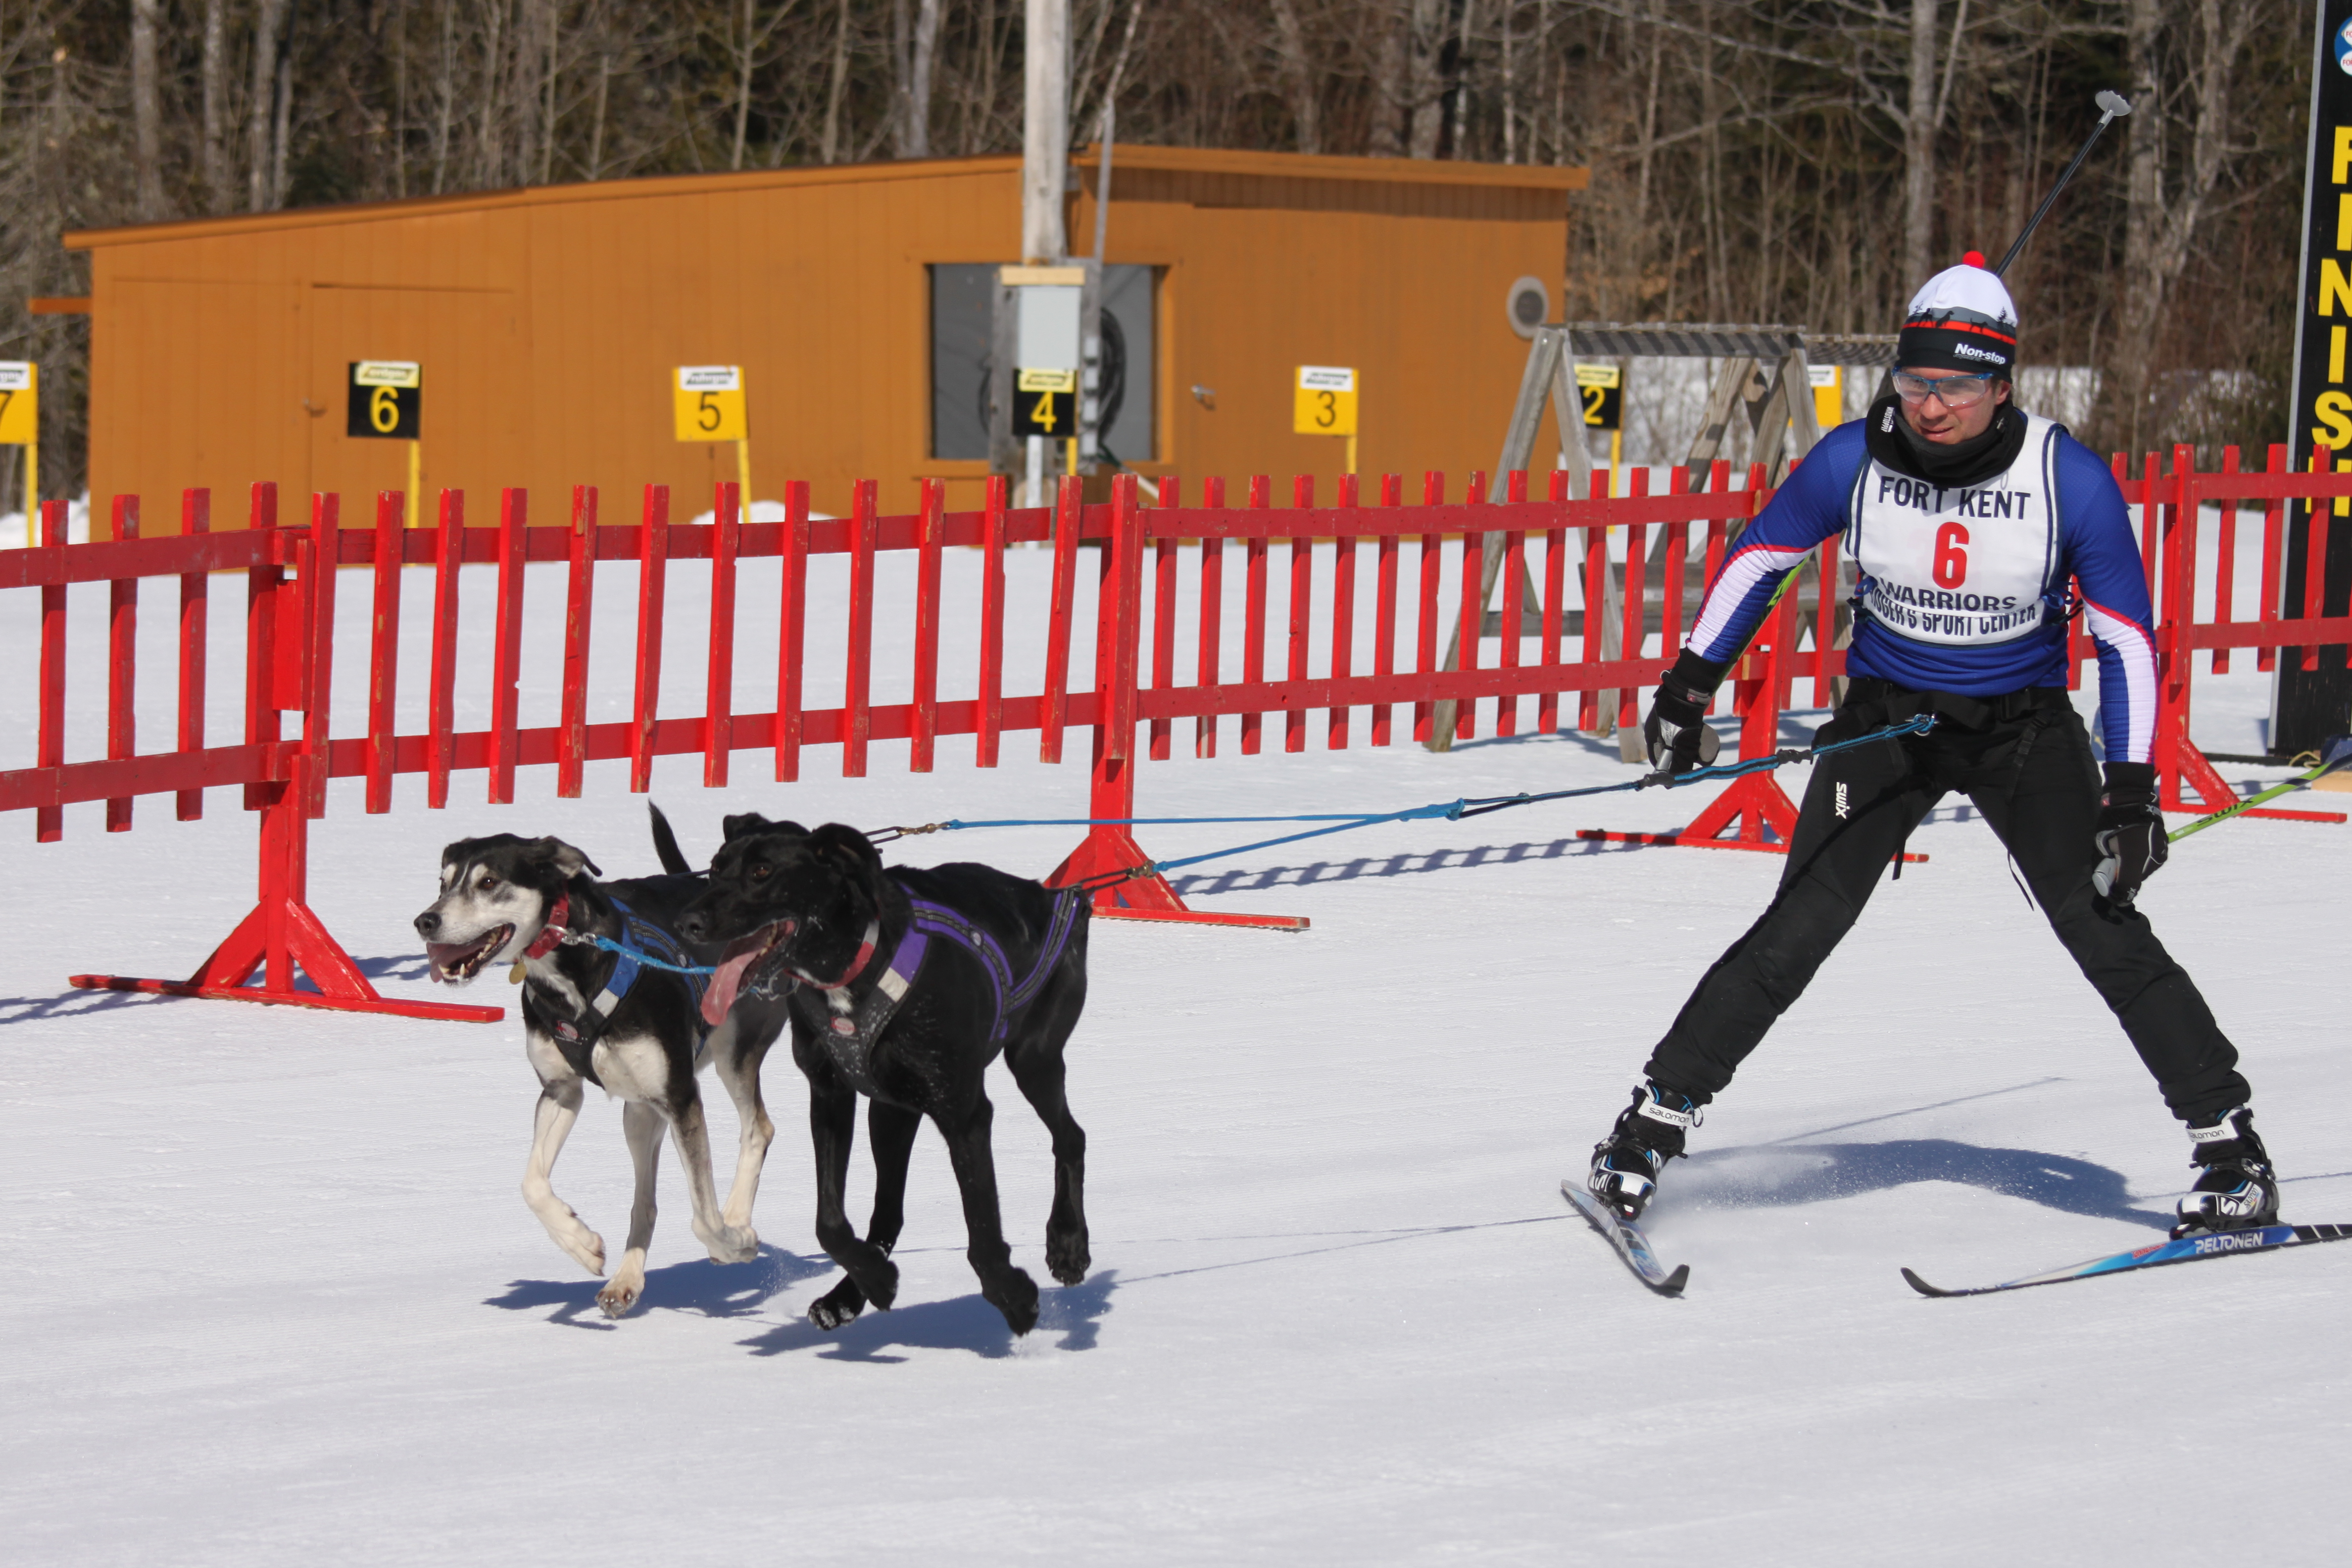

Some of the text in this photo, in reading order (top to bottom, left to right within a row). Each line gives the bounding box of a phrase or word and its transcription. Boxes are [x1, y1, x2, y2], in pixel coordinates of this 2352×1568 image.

[1954, 343, 2006, 365] Non-stop
[370, 386, 399, 433] 6
[698, 392, 721, 431] 5
[1030, 391, 1057, 433] 4
[1316, 390, 1335, 428] 3
[1583, 386, 1605, 425] 2
[1878, 476, 2031, 520] FORT KENT
[1932, 522, 1969, 590] 6
[1879, 577, 2017, 612] WARRIORS
[1922, 612, 1971, 637] SPORT
[1979, 603, 2037, 635] CENTER
[2194, 1231, 2263, 1254] PELTONEN
